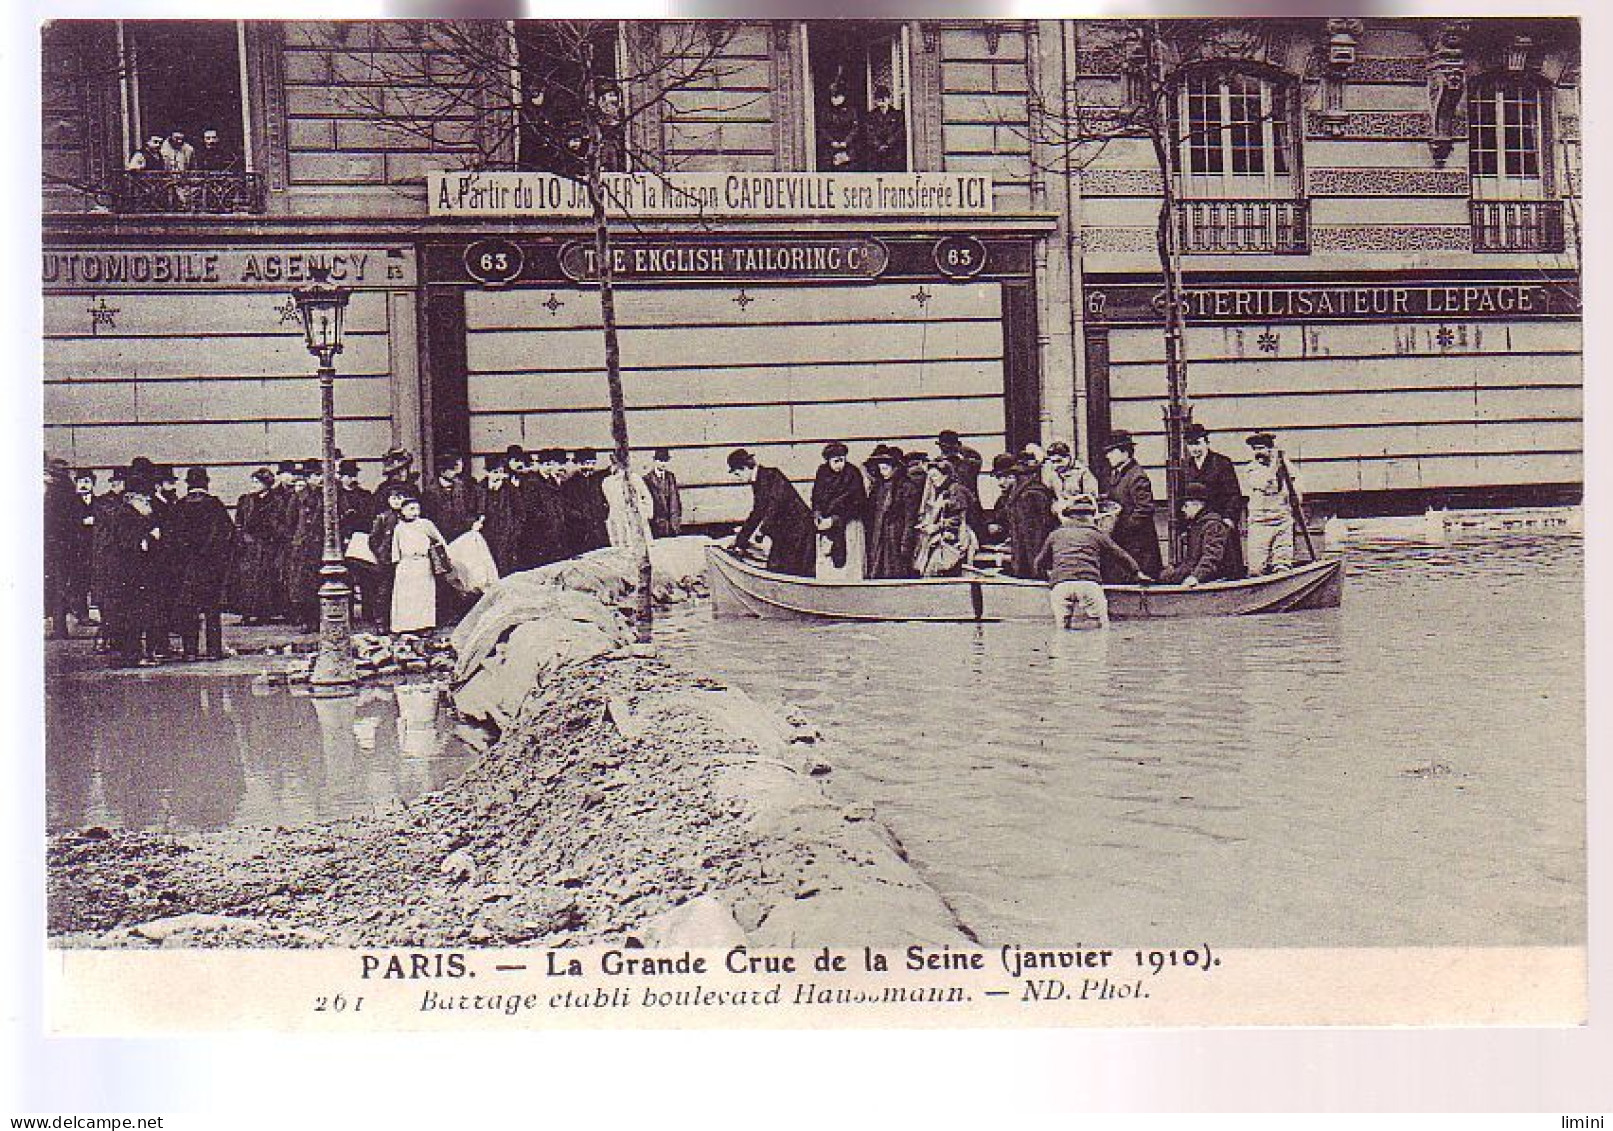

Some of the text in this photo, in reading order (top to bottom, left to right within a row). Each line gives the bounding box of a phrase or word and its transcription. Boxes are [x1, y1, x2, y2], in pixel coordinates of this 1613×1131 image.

[438, 176, 452, 209] A
[458, 176, 509, 209] Partir
[514, 177, 533, 209] du
[538, 177, 561, 209] 10
[661, 177, 718, 209] Maison
[725, 175, 836, 209] CAPDEVILLE
[843, 185, 873, 209] sera
[957, 177, 986, 208] ICI
[480, 252, 509, 270] 63
[584, 249, 626, 272] TE
[634, 248, 724, 272] ENGLISH
[732, 247, 842, 271] TAILORING
[1426, 287, 1533, 312] LEPAGE
